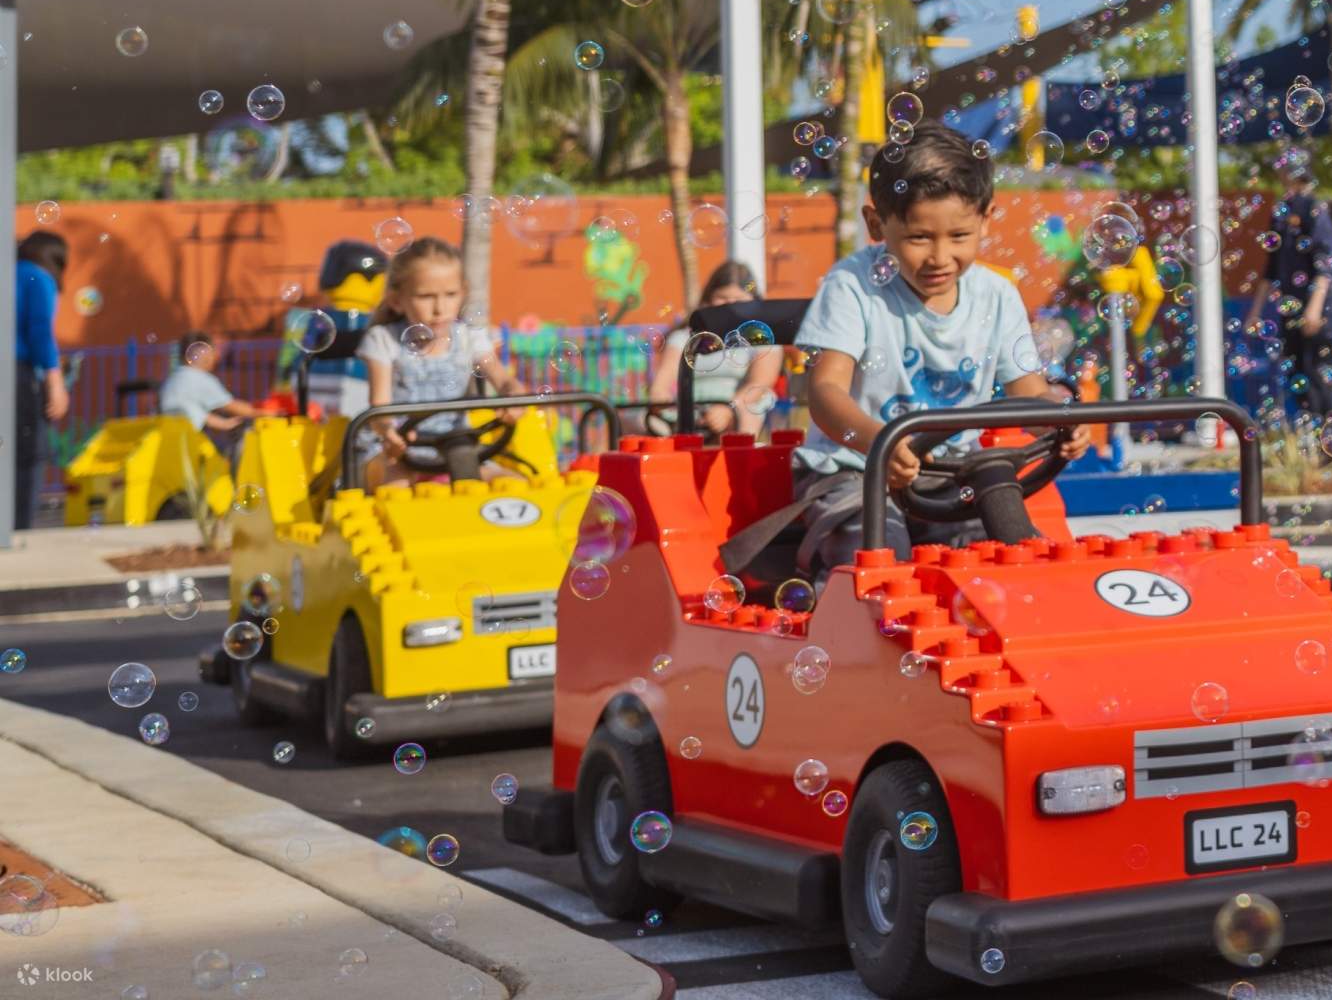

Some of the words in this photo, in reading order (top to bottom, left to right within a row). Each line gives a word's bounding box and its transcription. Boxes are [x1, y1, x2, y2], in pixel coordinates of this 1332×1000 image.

[1108, 580, 1179, 606] 24
[731, 676, 760, 724] 24
[1200, 825, 1244, 852] LLC
[1253, 821, 1282, 847] 24
